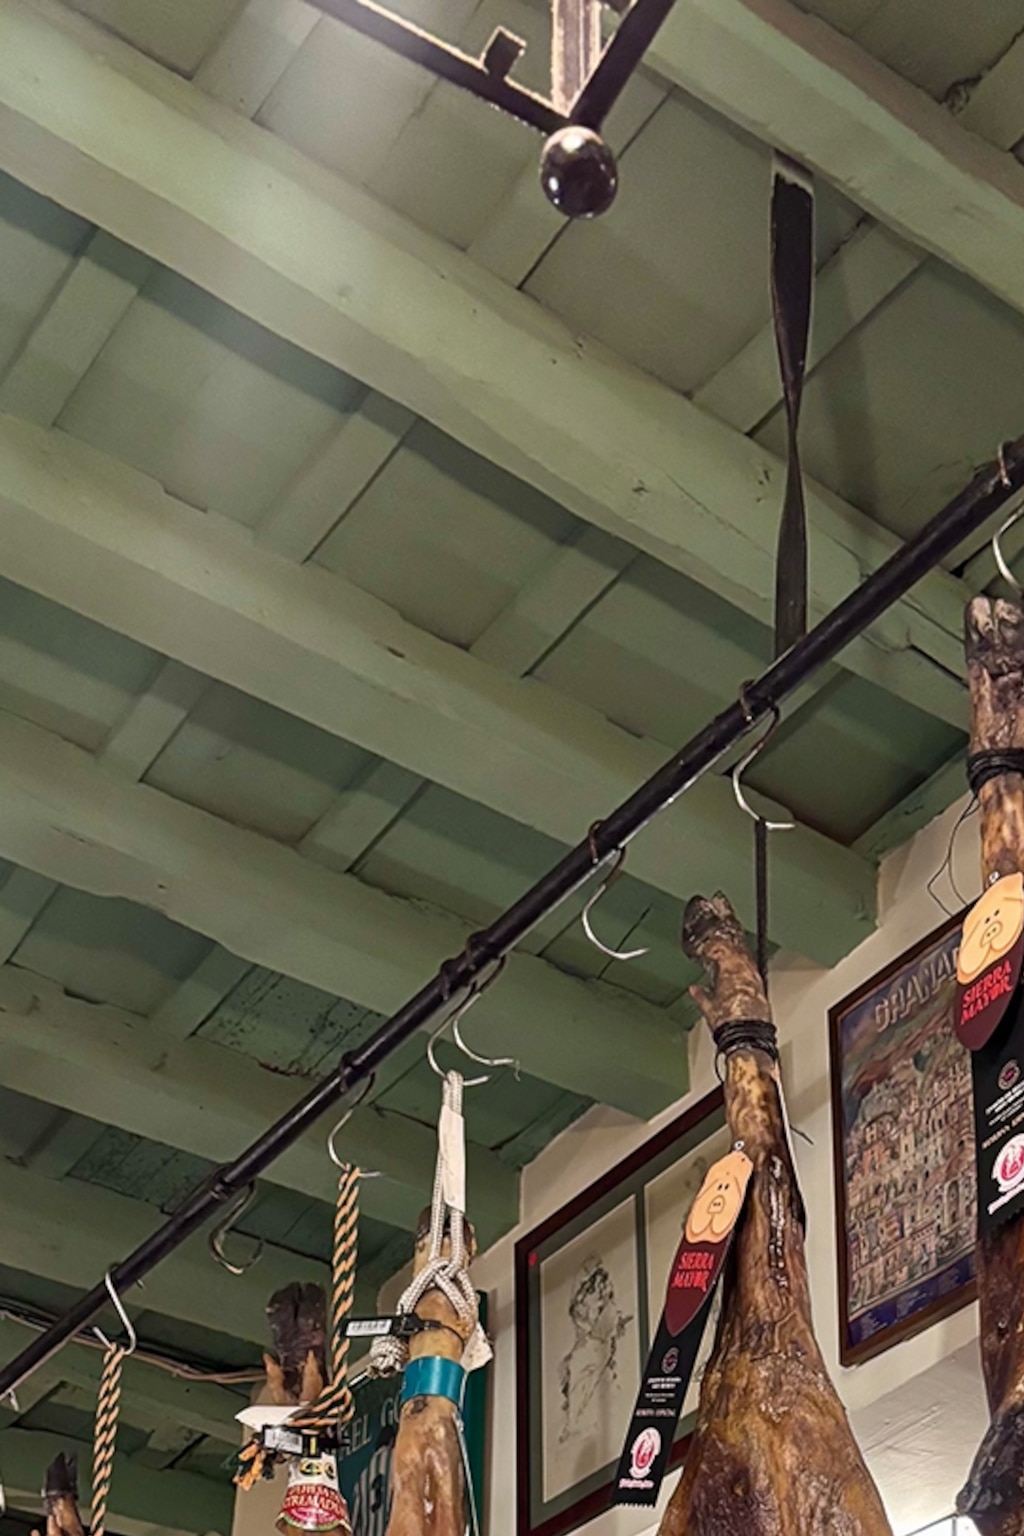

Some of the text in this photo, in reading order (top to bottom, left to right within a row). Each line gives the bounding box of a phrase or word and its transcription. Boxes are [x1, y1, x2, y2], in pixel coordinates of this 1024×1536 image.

[960, 976, 1013, 1026] MAYOR
[962, 960, 1012, 1008] SIERRA
[678, 1252, 715, 1270] SIERRA
[672, 1271, 709, 1292] MAYOR
